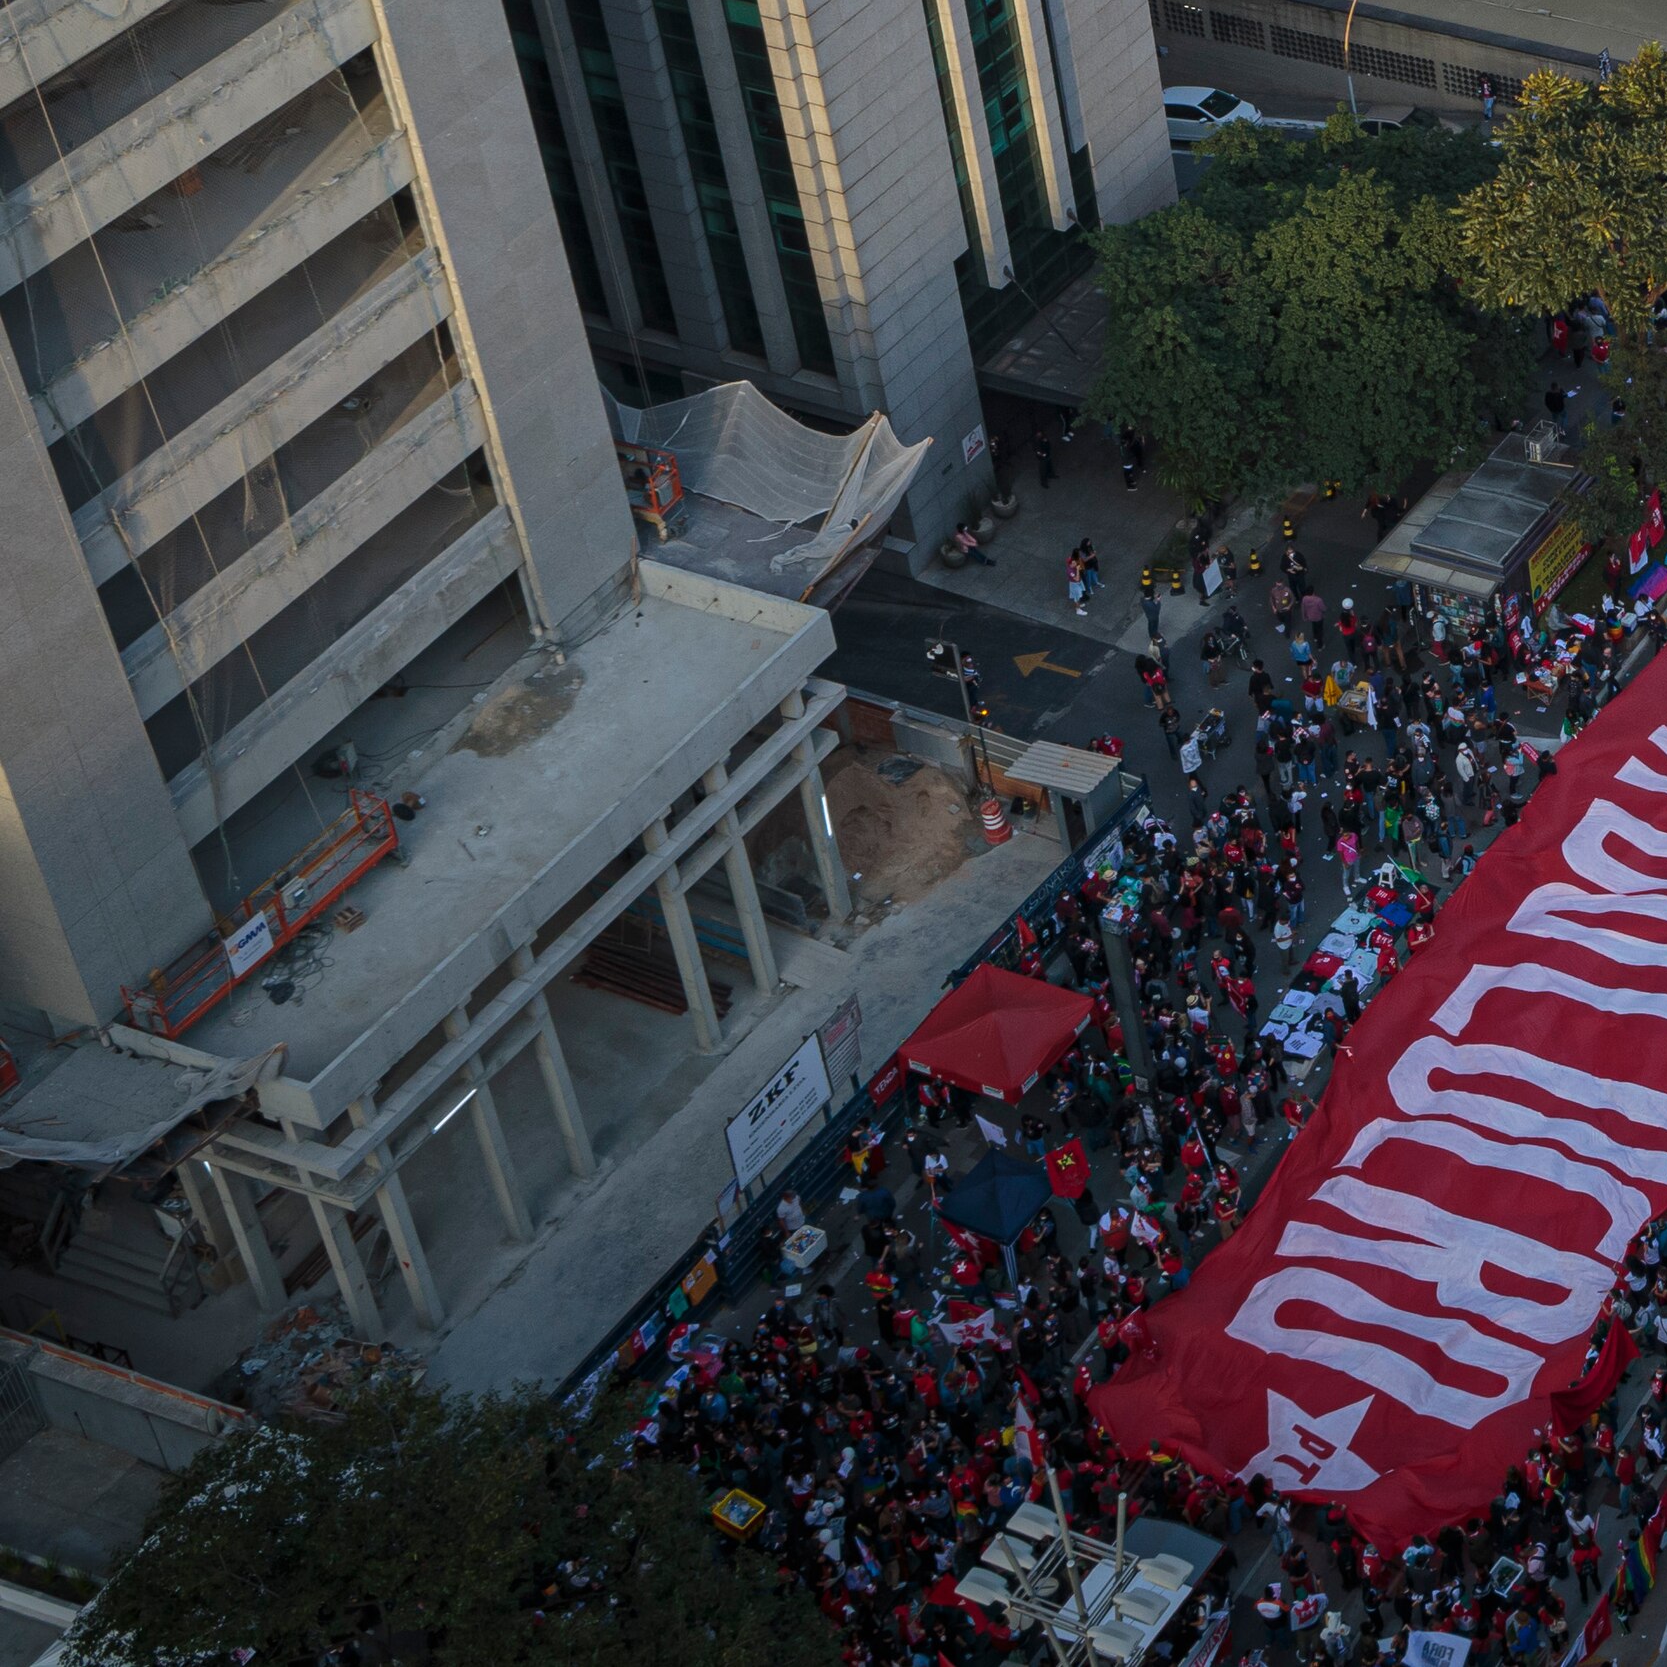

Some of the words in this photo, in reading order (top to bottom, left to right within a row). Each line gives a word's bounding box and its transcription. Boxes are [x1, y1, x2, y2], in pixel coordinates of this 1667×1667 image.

[748, 1060, 800, 1126] ZKF
[874, 1066, 899, 1095] TENDA
[1272, 1424, 1338, 1485] PT
